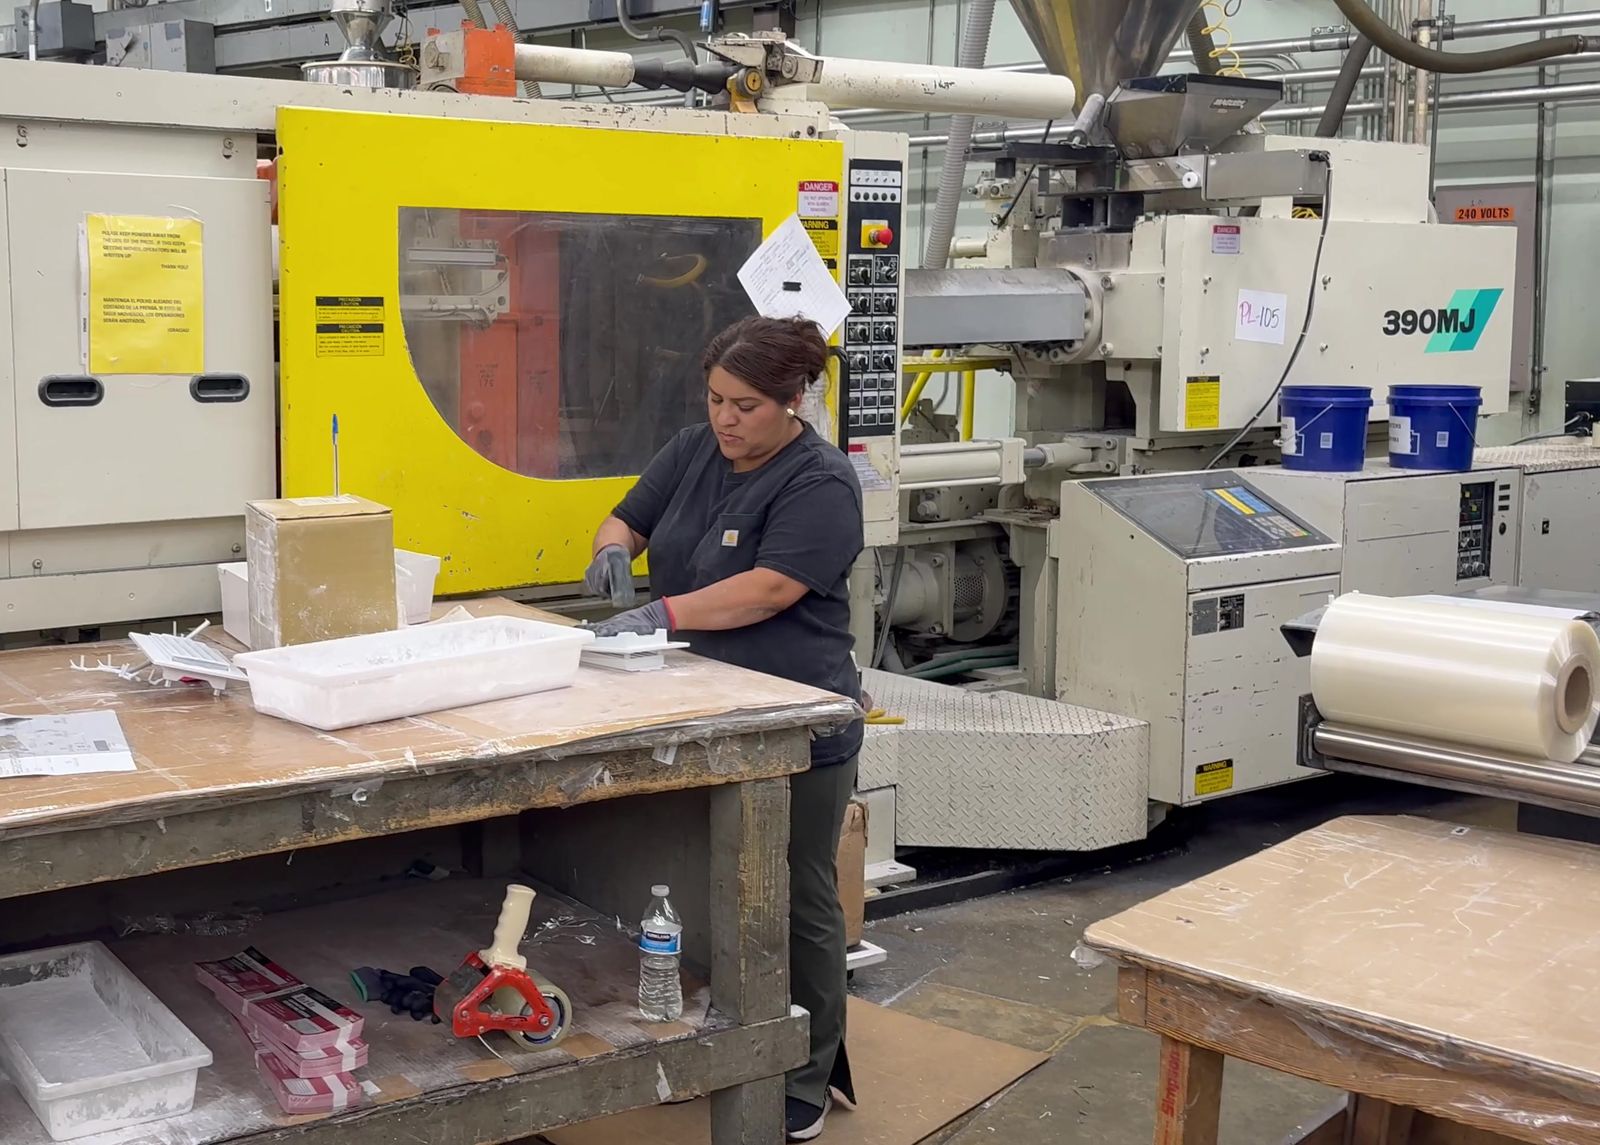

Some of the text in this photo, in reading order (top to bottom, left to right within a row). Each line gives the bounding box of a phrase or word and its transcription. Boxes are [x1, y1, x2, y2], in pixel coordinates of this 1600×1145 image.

[804, 183, 833, 191] DANGER
[1459, 208, 1509, 219] 240 VOLTS
[1239, 300, 1280, 328] PL-105
[1383, 308, 1475, 336] 390MJ
